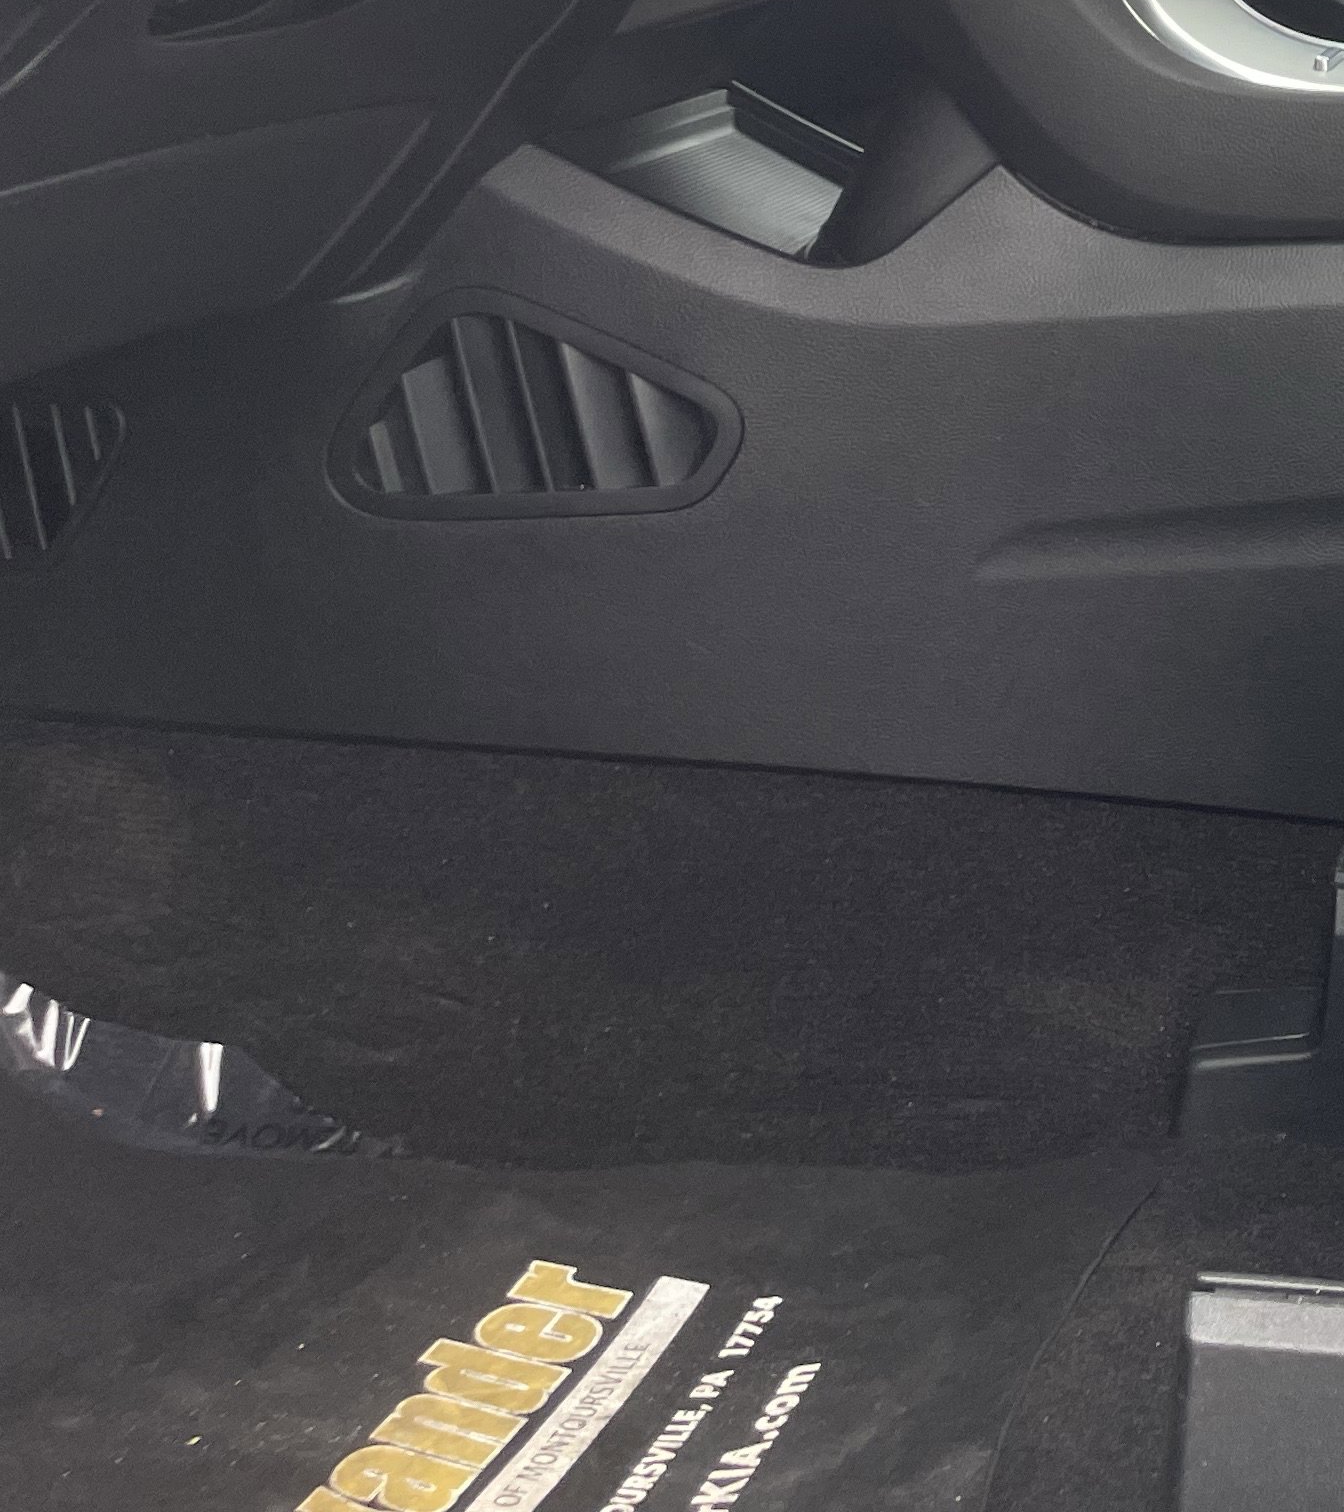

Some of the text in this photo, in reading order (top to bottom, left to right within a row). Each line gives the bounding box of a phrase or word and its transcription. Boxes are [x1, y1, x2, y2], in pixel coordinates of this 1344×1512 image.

[689, 1369, 735, 1399] PA
[718, 1294, 784, 1360] 17754
[494, 1341, 652, 1508] OF MONTOURSVILLE
